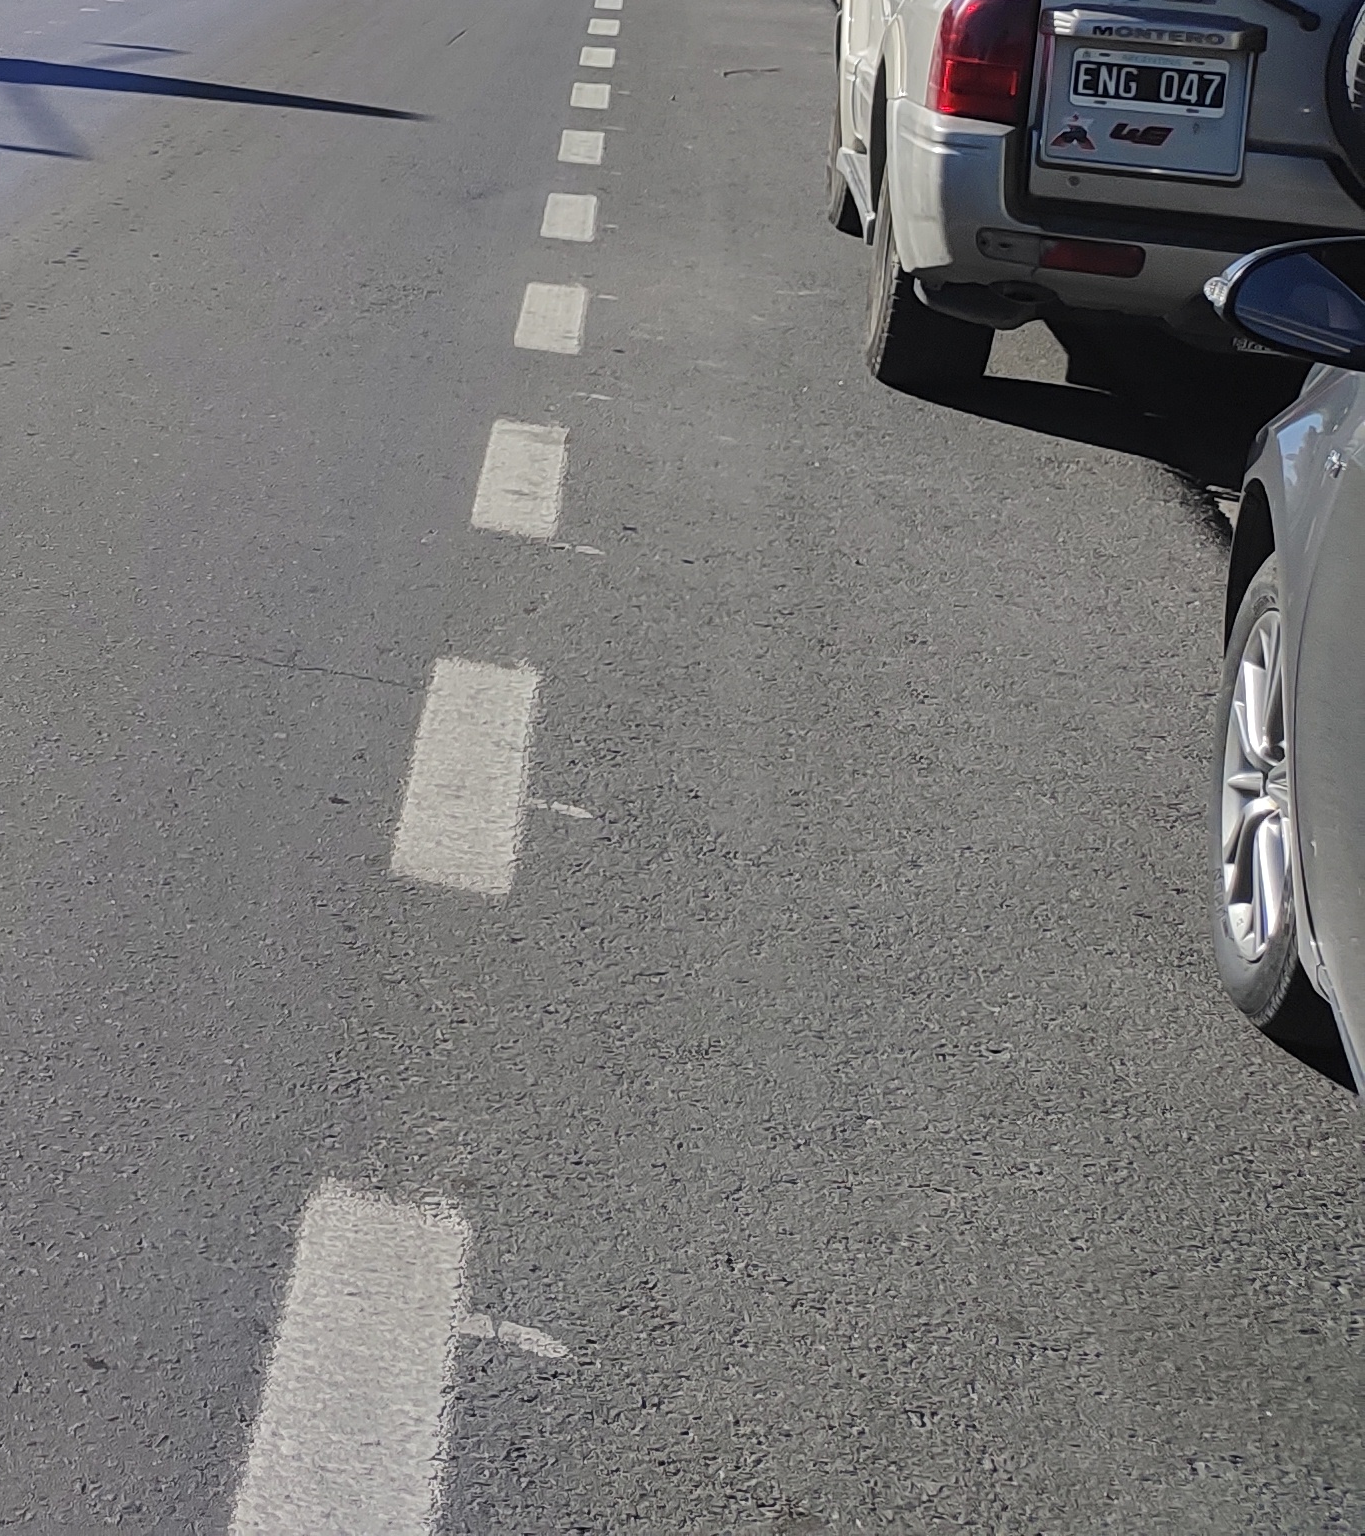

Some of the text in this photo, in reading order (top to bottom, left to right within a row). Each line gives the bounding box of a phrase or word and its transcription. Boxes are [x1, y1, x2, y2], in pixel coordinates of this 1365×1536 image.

[1092, 25, 1225, 45] MONTERO
[1077, 64, 1221, 105] ENG 047
